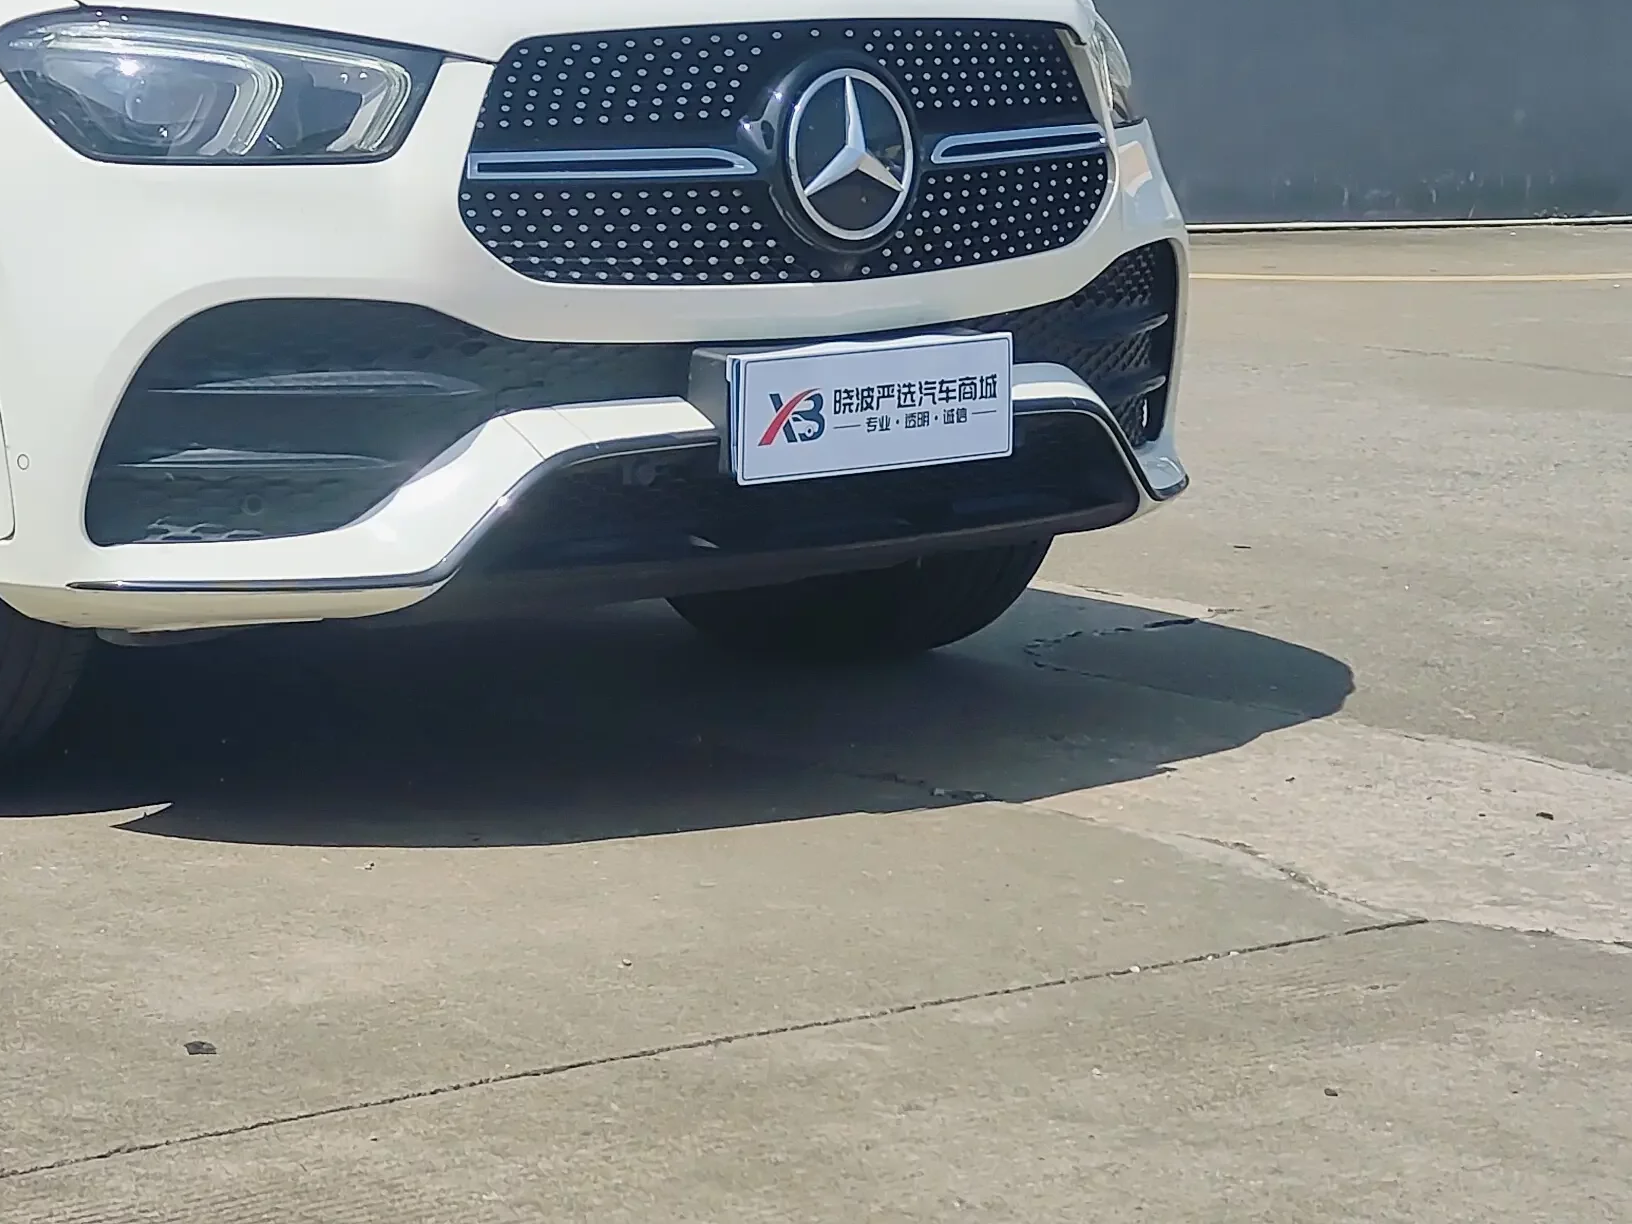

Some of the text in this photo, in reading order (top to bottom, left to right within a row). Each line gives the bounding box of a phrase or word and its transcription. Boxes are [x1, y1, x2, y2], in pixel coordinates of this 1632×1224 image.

[833, 374, 997, 415] 晓波严选汽车商城
